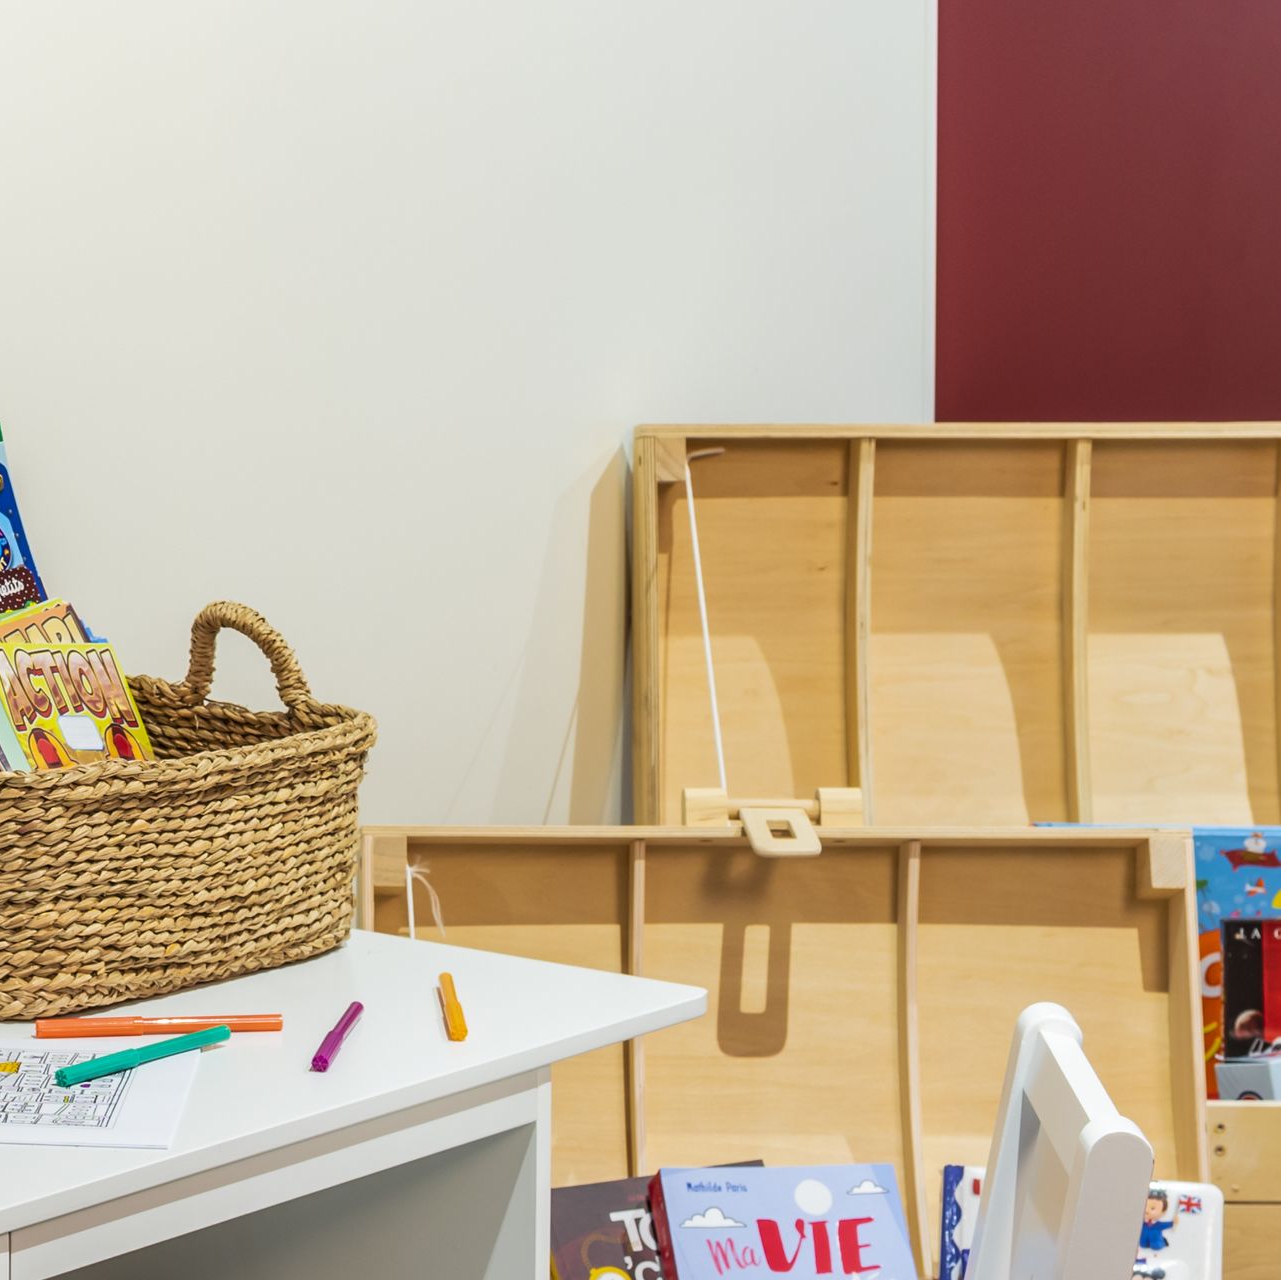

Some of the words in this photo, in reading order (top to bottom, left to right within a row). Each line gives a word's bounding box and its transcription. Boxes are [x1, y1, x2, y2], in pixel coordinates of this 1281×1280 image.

[686, 1181, 722, 1193] Mathilde
[726, 1181, 748, 1193] Paris
[705, 1237, 762, 1276] Ma
[756, 1216, 882, 1275] VIE
